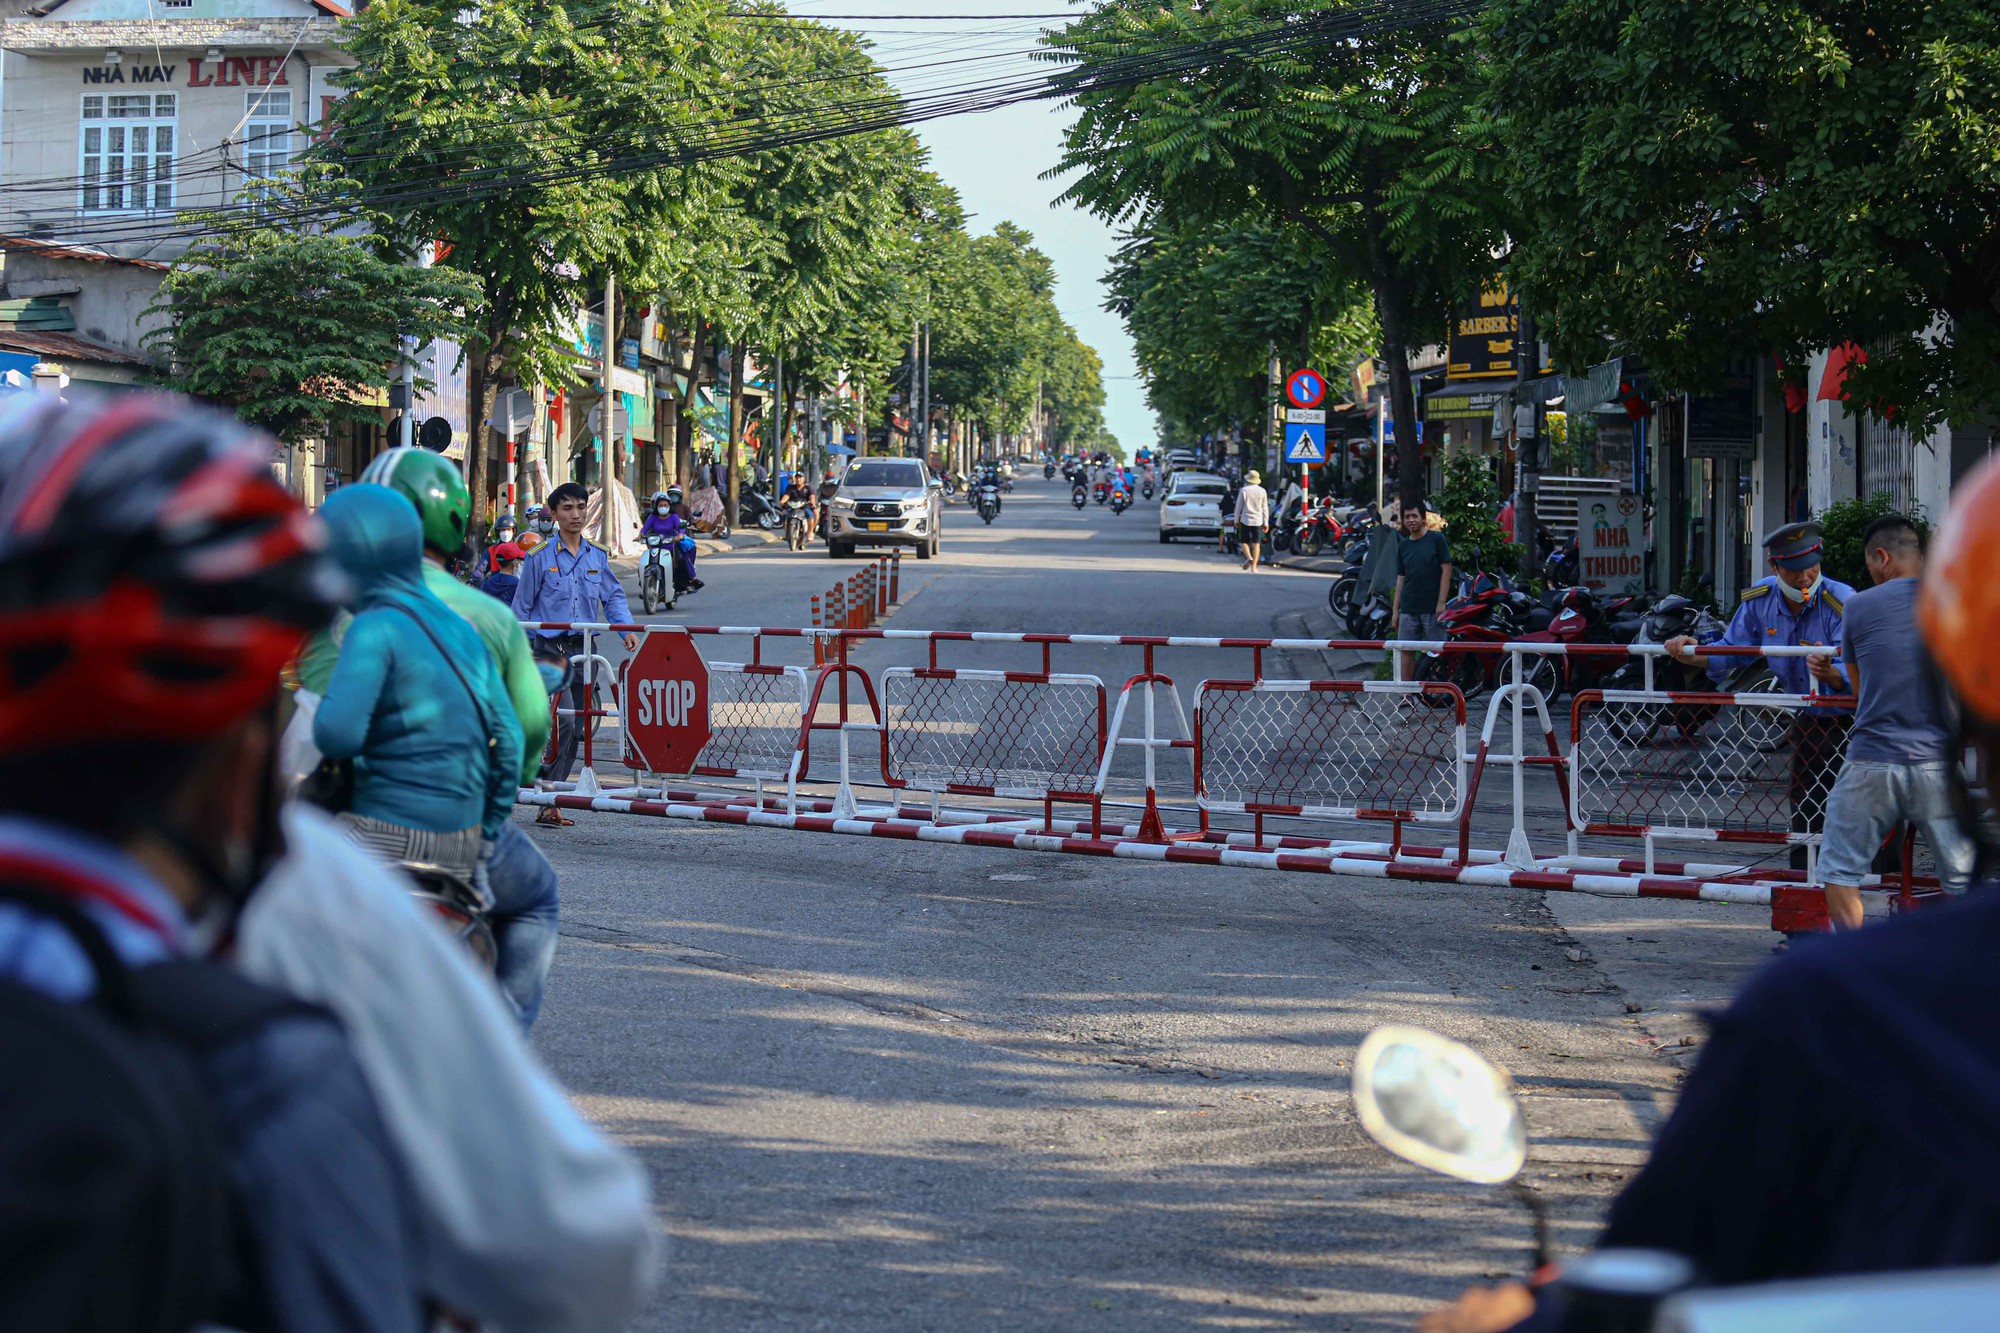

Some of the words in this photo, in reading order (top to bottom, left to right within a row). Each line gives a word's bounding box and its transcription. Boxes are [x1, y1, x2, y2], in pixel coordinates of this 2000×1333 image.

[83, 63, 124, 84] NHÀ
[132, 65, 176, 83] MAY
[187, 56, 289, 87] LINH
[1459, 316, 1509, 336] BARBER
[1595, 524, 1631, 548] NHÀ
[1583, 549, 1642, 577] THUỐC
[638, 678, 696, 727] STOP
